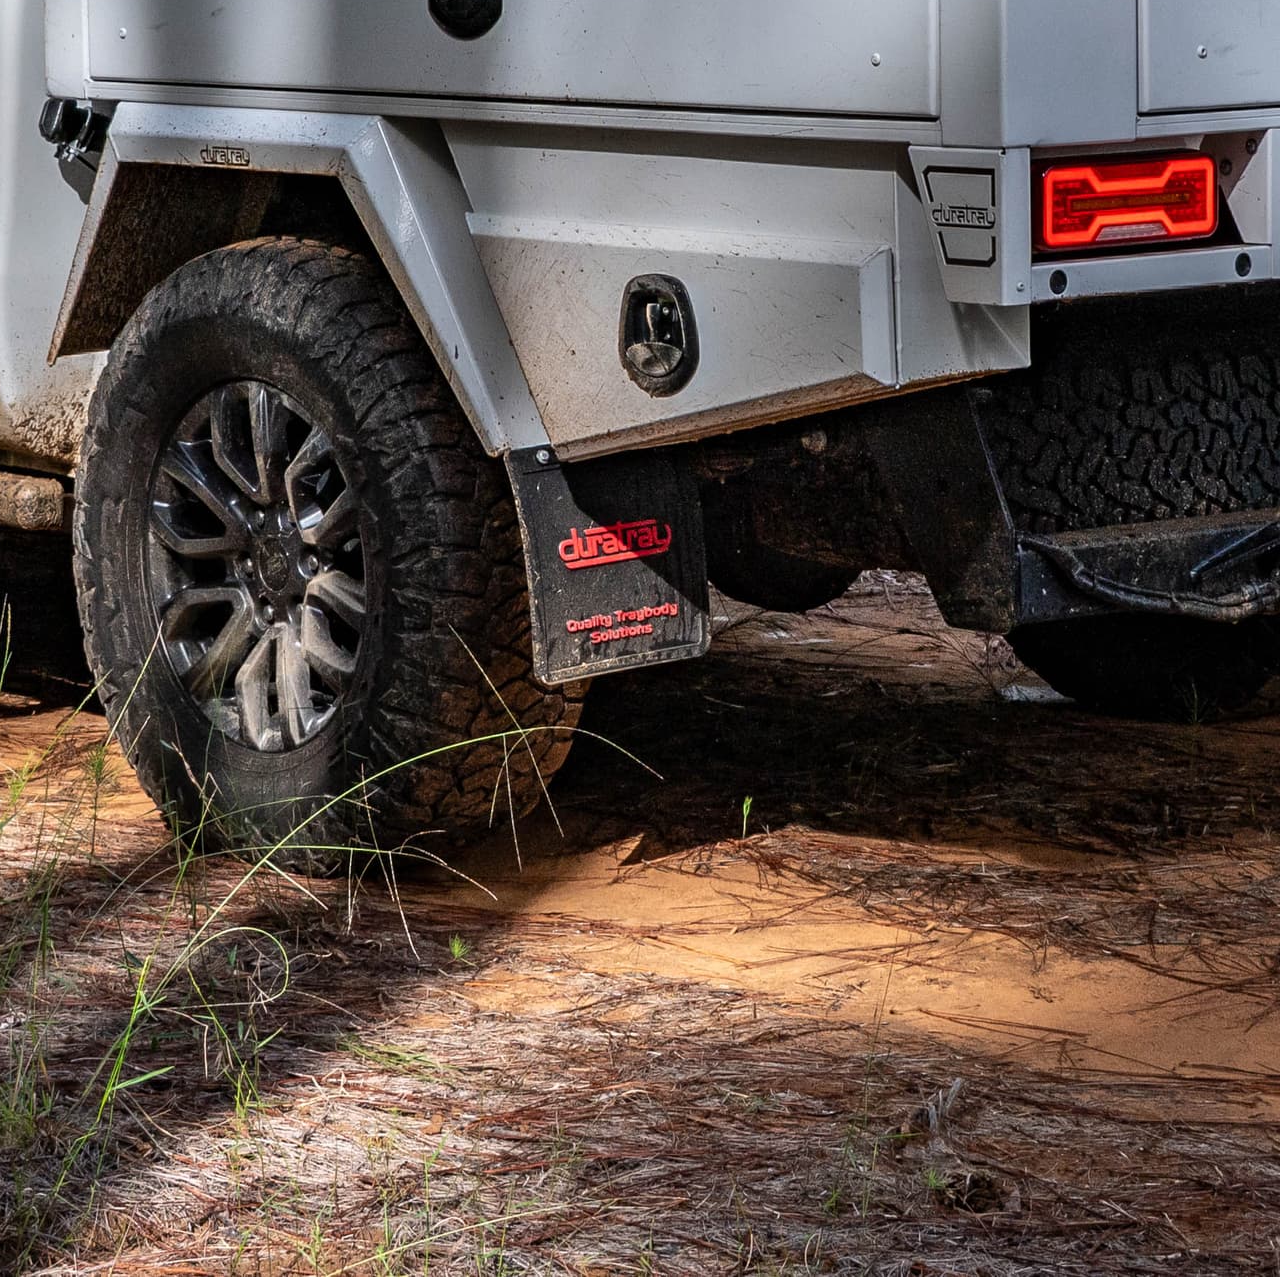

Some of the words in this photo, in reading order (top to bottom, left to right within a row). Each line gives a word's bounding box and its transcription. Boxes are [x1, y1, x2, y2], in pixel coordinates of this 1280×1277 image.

[932, 203, 996, 230] duratray
[558, 519, 672, 569] duratray
[566, 614, 613, 634] Quality
[614, 602, 678, 621] Traybody
[590, 623, 653, 644] Solutions
